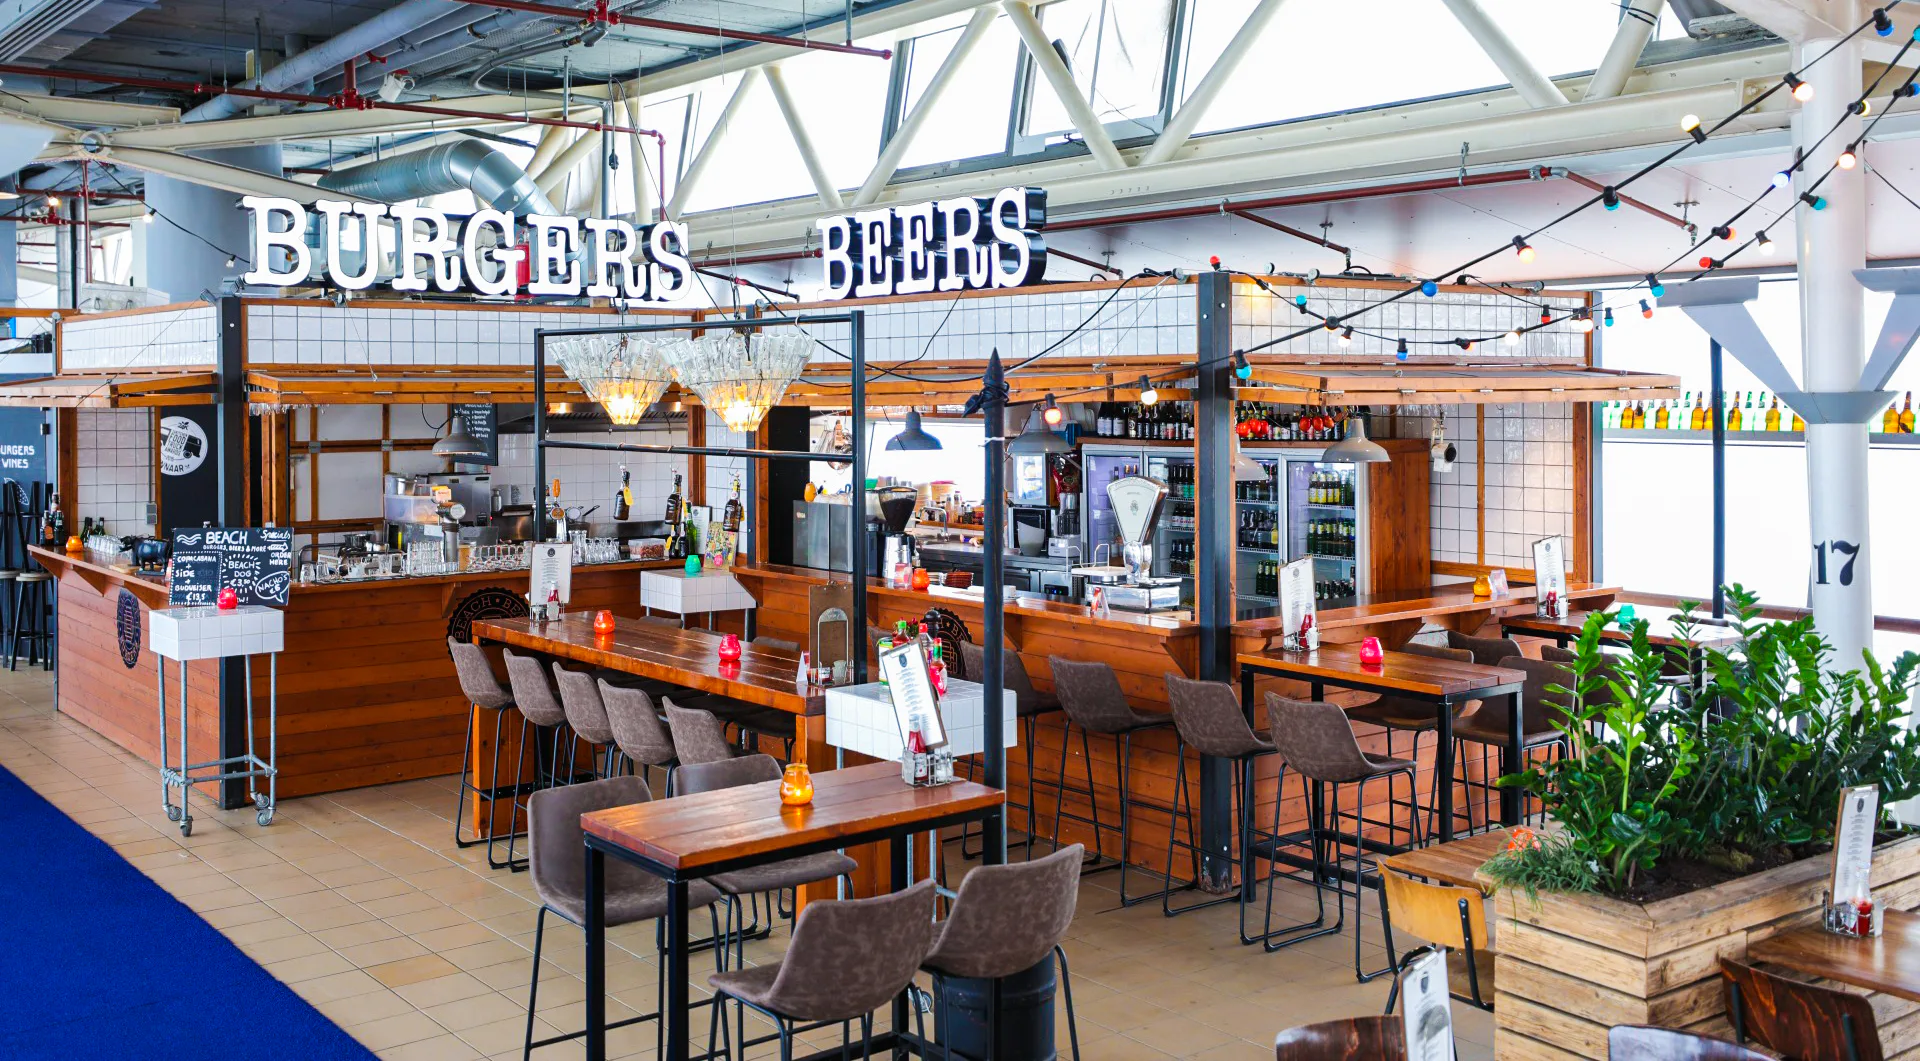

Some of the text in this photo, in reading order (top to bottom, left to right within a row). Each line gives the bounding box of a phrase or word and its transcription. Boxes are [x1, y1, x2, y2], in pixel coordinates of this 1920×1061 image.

[242, 195, 692, 301] BURGERS
[816, 187, 1030, 300] BEERS
[0, 445, 35, 455] URGERS
[2, 458, 29, 468] WINES
[206, 531, 248, 545] BEACH
[228, 560, 255, 569] BEACH
[1813, 539, 1861, 587] 17
[234, 570, 251, 578] DOG
